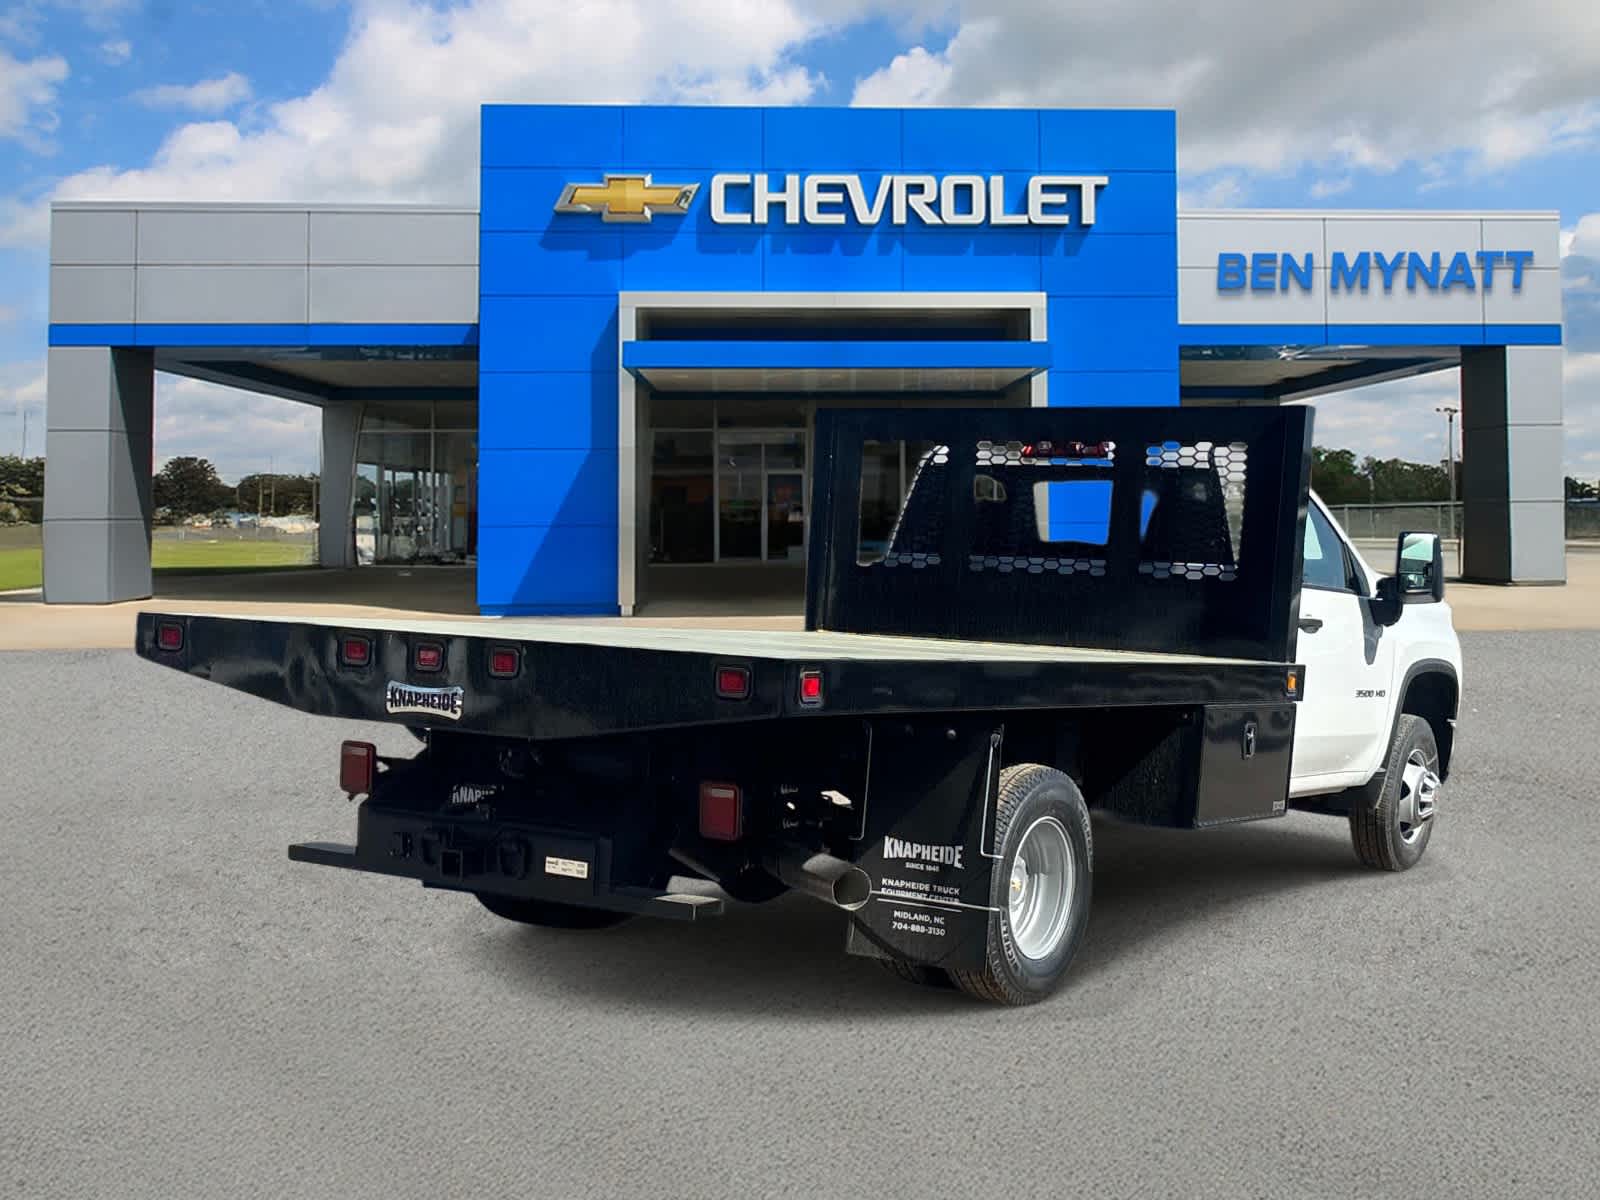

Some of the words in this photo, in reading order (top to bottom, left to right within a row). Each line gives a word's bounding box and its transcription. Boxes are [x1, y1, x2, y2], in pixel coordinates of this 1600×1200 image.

[710, 173, 1109, 225] CHEVROLET
[1216, 252, 1313, 291] BEN
[1330, 250, 1534, 291] MYNATT
[390, 685, 460, 715] KNAPHEIDE
[883, 835, 964, 869] KNAPHEIDE
[881, 878, 930, 892] KNAPHEIDE
[933, 885, 960, 896] TRUCK
[933, 916, 945, 925] NC
